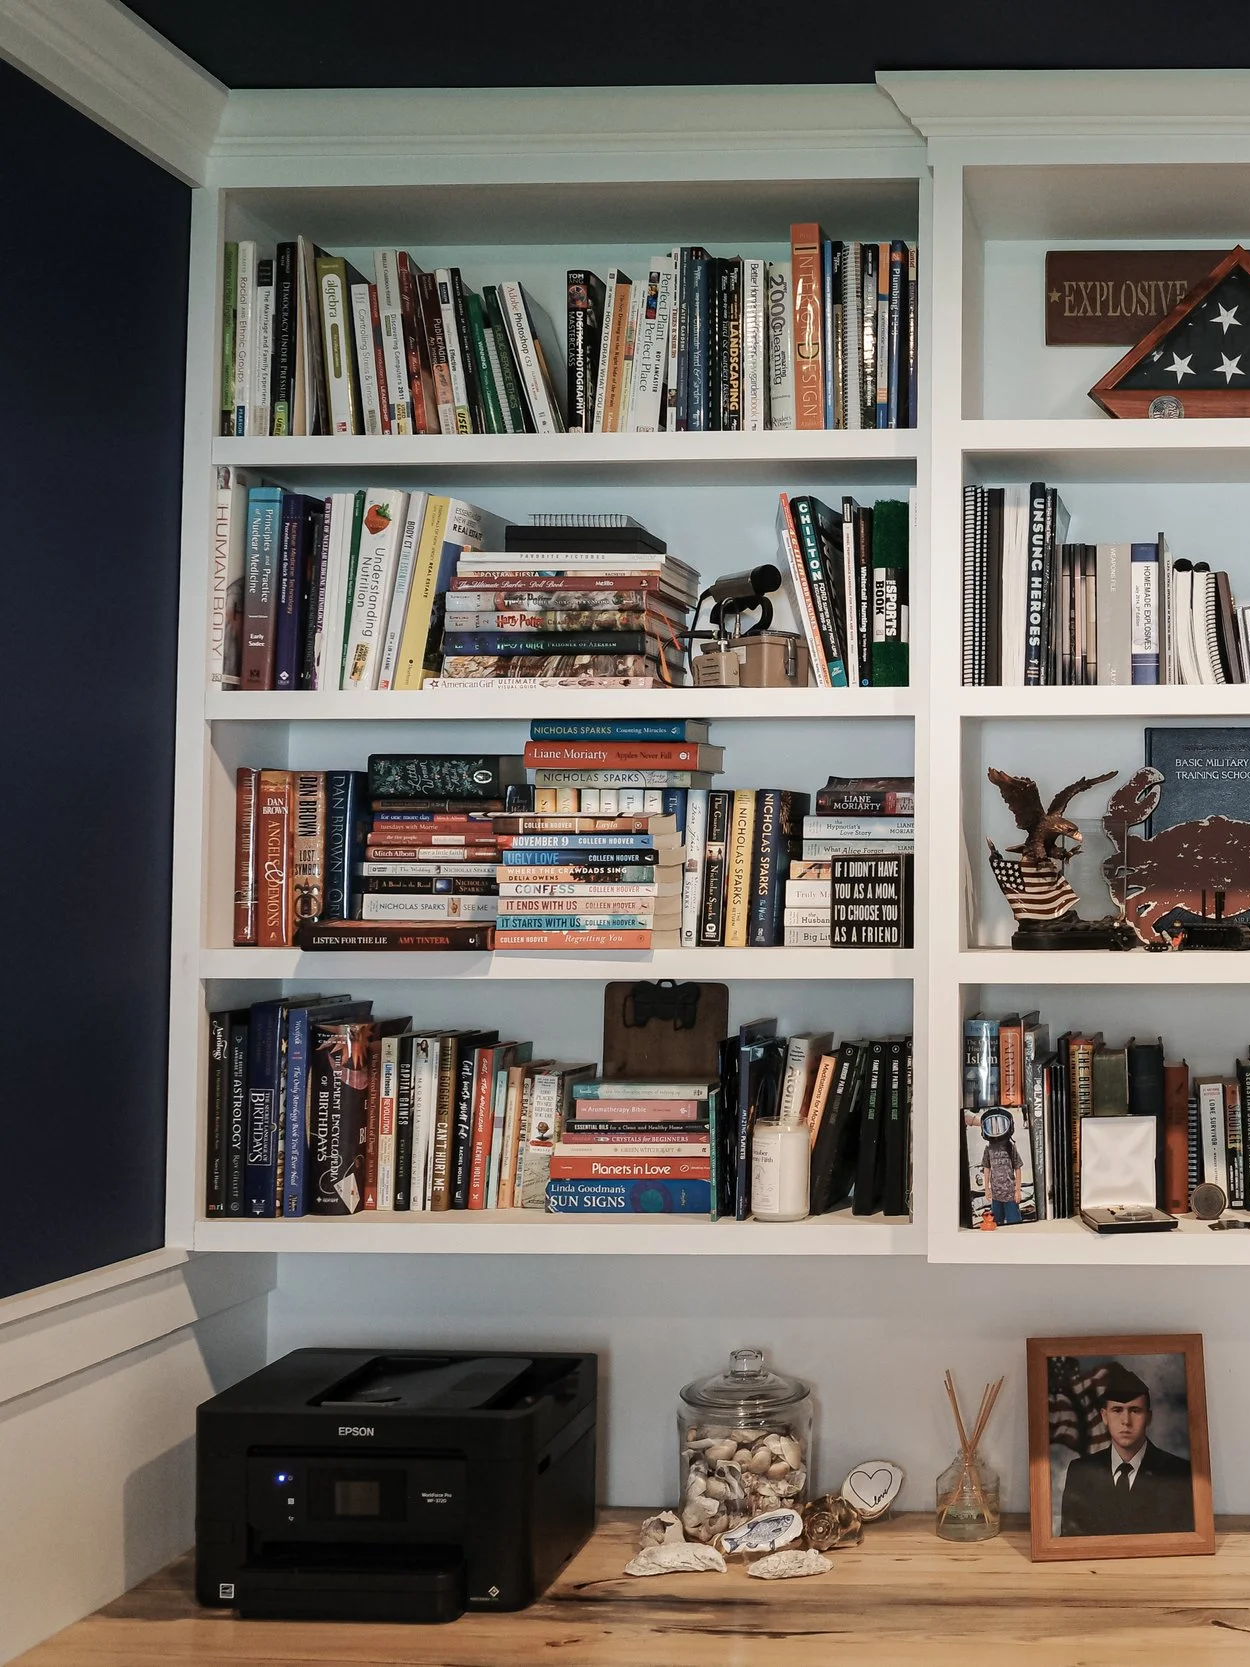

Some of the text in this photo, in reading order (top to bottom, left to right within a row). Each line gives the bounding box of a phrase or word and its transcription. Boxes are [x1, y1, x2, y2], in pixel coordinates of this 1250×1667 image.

[326, 280, 343, 318] algebra
[655, 272, 672, 341] Perfect Plant
[769, 273, 786, 330] 2000
[890, 268, 900, 310] Plumbing
[1063, 280, 1188, 316] EXPLOSIVE
[261, 304, 271, 334] Marriage
[280, 281, 291, 363] DEMOCRACY UNDER
[357, 308, 369, 351] Controlling
[390, 314, 400, 350] Discovering
[507, 286, 529, 354] Adobe Photoshop
[237, 351, 247, 383] Groups
[639, 322, 656, 392] Perfect Place
[729, 321, 739, 411] LANDSCAPING
[771, 322, 784, 386] Cleaning
[575, 352, 584, 415] PHOTOGRAPHY
[797, 342, 820, 417] DESIGN
[249, 517, 262, 594] Nuclear Medicine
[261, 508, 274, 603] Principles Practice
[799, 503, 823, 581] CHILTON
[212, 506, 229, 657] HUMAN BODY
[356, 557, 373, 608] Nutrition
[362, 547, 386, 637] Understanding
[1029, 497, 1044, 647] UNSUNG HEROES
[859, 602, 868, 633] Hunting
[875, 580, 884, 616] BOOK
[885, 586, 897, 636] SPORTS
[1144, 565, 1152, 650] HOMEMADE EXPLOSIVES
[495, 613, 544, 629] Harry Potter
[440, 680, 479, 688] American
[533, 726, 612, 734] NICHOLAS SPARKS
[534, 748, 608, 762] Liane Moriarty
[1175, 758, 1249, 767] BASIC MILITARY
[1176, 771, 1219, 780] TRAINING
[543, 774, 599, 782] NICHOLAS
[603, 774, 639, 782] SPARKS
[844, 795, 871, 803] LIANE
[298, 776, 318, 837] DAN BROWN
[330, 775, 345, 872] DAN BROWN
[833, 802, 881, 810] MORIARTY
[268, 820, 281, 864] ANGELS
[507, 853, 614, 865] UGLY LOVE COLLEEN
[512, 836, 569, 847] NOVEMBER 9
[732, 807, 748, 905] NICHOLAS SPARKS
[758, 792, 774, 896] NICHOLAS SPARKS
[515, 884, 575, 893] CONFESS
[834, 861, 899, 878] IF I DIDN'T HAVE
[506, 901, 578, 910] IT ENDS WITH US
[834, 882, 898, 900] YOU AS A MOM,
[501, 918, 581, 928] IT STARTS WITH US
[834, 904, 898, 921] I'D CHOOSE YOU
[313, 936, 340, 944] LISTEN
[834, 926, 898, 943] AS A FRIEND
[232, 1079, 244, 1149] ASTROLOGY
[397, 1063, 411, 1125] CAPITAL GAINES
[1033, 1077, 1043, 1118] POLAND
[248, 1092, 265, 1163] BIRTHDAYS
[317, 1091, 329, 1162] BIRTHDAYS
[330, 1070, 343, 1182] ELEMENT ENCYCLOPEDIA
[1208, 1098, 1218, 1146] LONE SURVIVOR
[433, 1122, 448, 1192] CAN'T HURT ME
[473, 1141, 483, 1188] RACHEL HOLLIS
[591, 1163, 672, 1175] Planets in Love
[550, 1195, 626, 1208] SUN SIGNS
[551, 1184, 626, 1195] Linda Goodman's
[338, 1427, 374, 1436] EPSON
